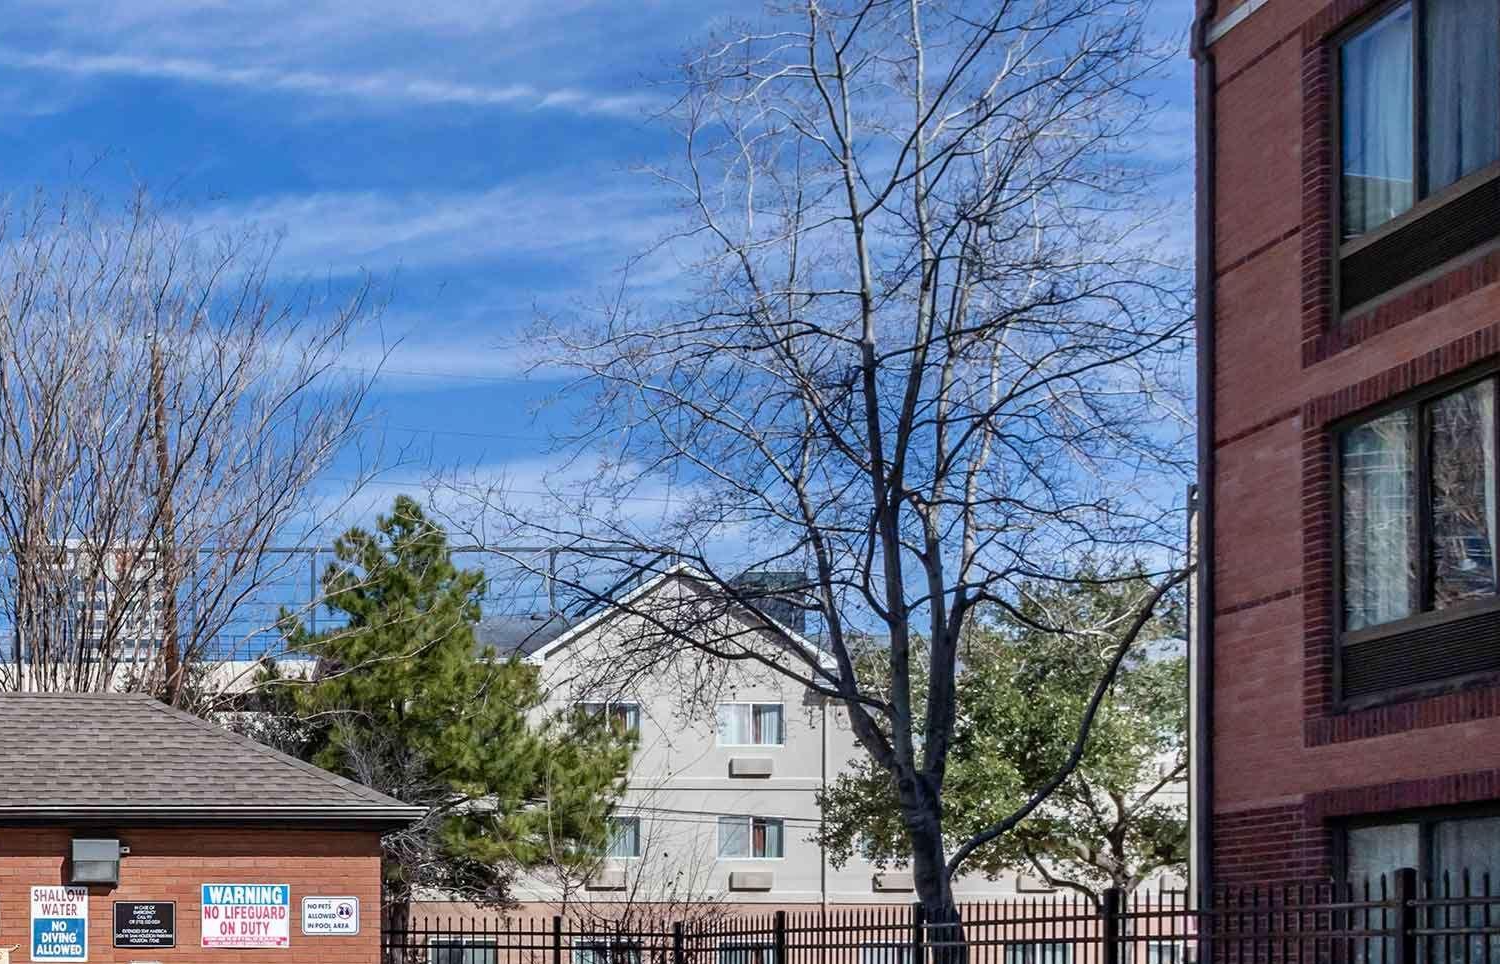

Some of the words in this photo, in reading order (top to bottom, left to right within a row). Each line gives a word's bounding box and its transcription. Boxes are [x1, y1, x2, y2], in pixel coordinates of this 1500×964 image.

[34, 889, 85, 902] SHALLOW
[209, 886, 282, 904] WARNING
[41, 903, 77, 916] WATER
[204, 906, 219, 919] NO
[225, 906, 285, 919] LIFEGUARD
[52, 921, 67, 932] NO
[220, 922, 235, 934] ON
[241, 922, 269, 934] DUTY
[42, 932, 76, 944] DIVING
[36, 944, 82, 955] ALLOWED
